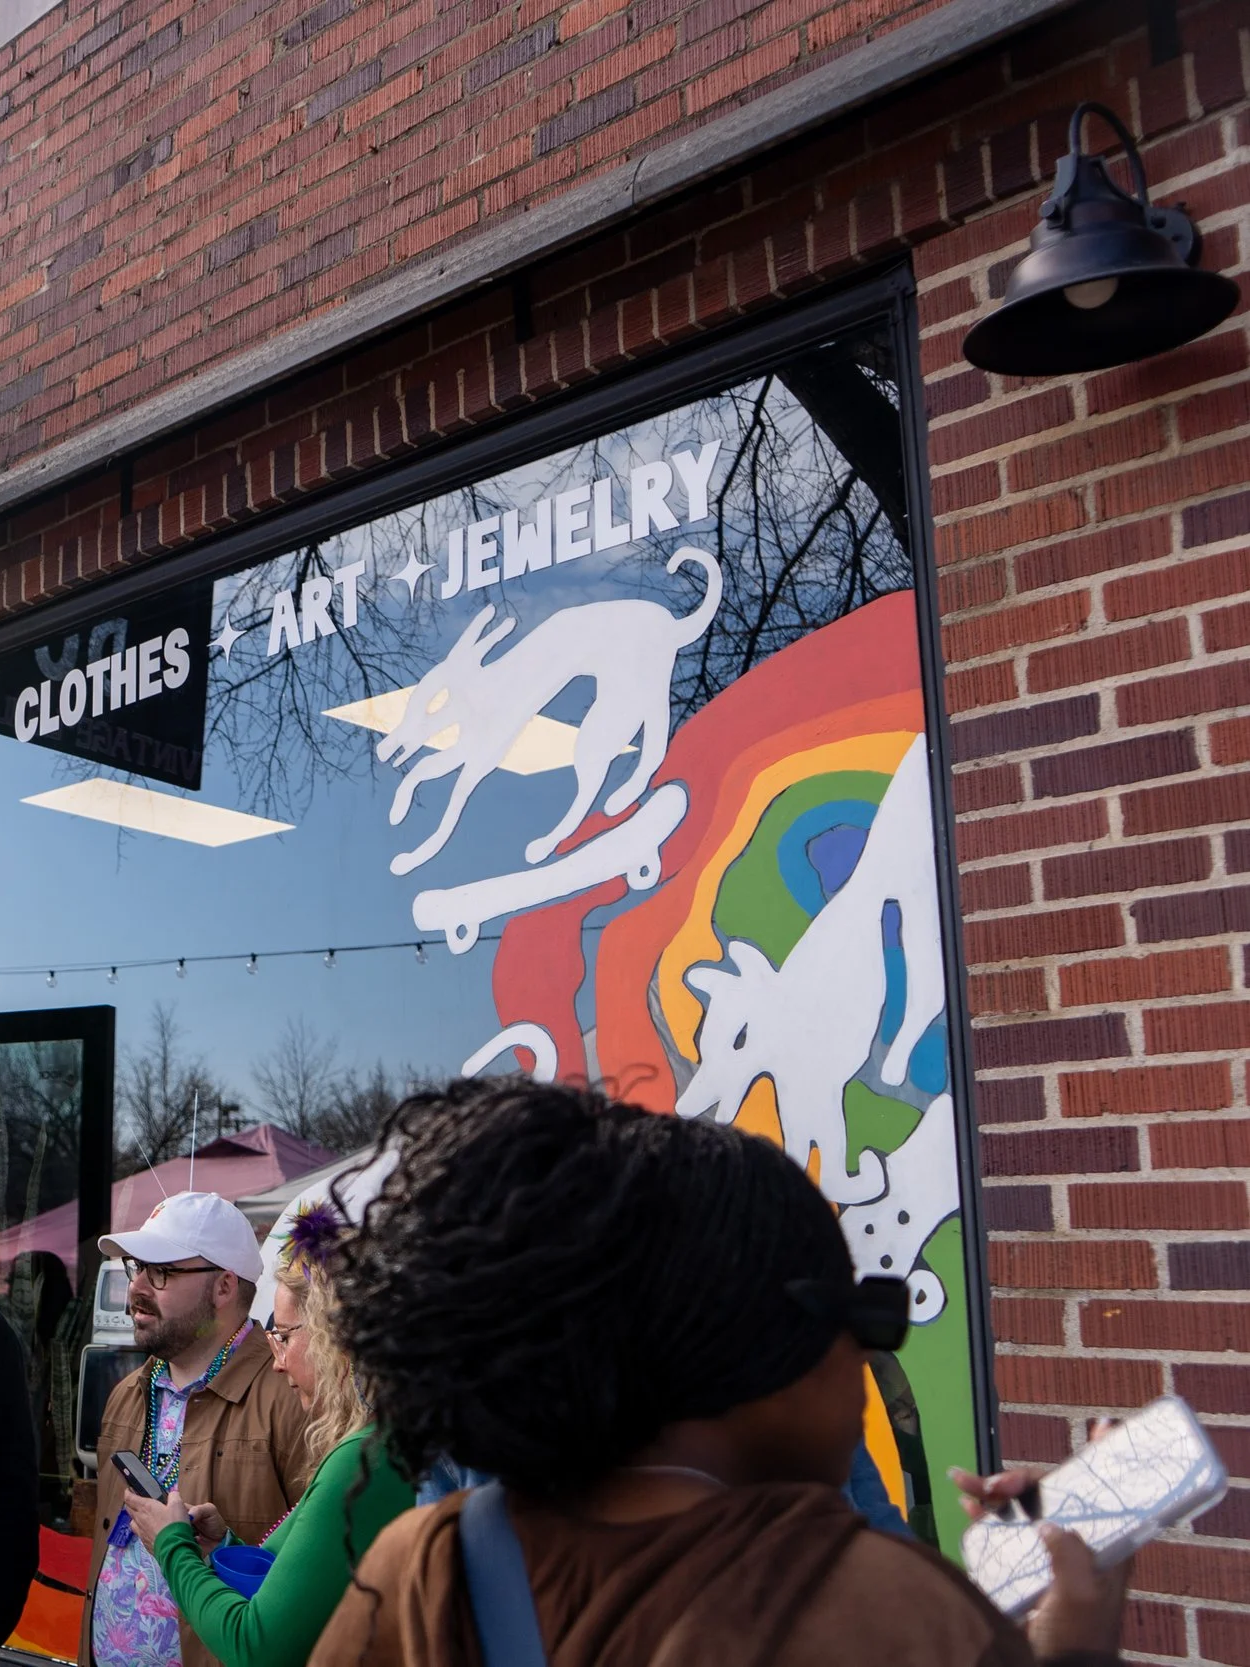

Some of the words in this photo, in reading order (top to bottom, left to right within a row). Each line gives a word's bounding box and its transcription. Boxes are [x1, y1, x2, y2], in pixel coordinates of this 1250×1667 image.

[14, 627, 191, 743] CLOTHES
[266, 559, 366, 657] ART
[441, 439, 722, 600] JEWELRY
